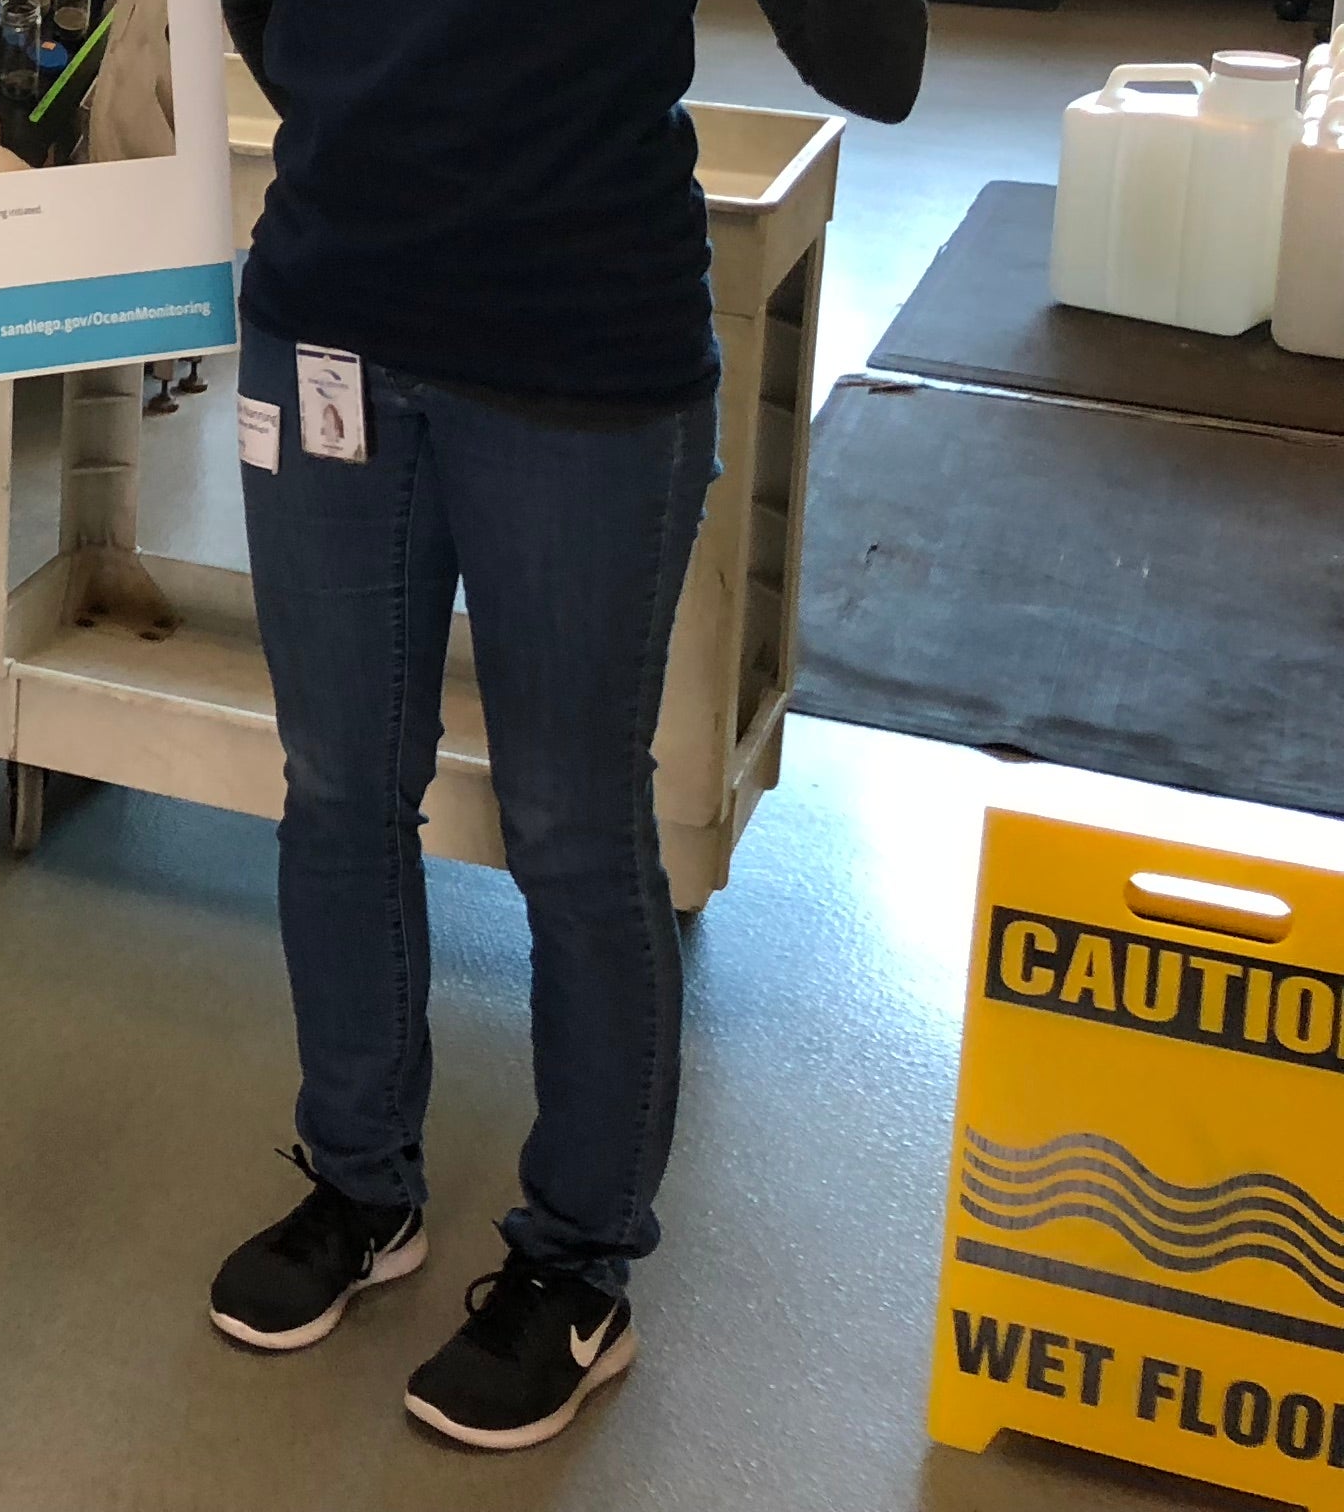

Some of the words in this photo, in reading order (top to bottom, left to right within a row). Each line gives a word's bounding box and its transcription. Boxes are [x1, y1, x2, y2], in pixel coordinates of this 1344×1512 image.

[0, 300, 212, 338] sandiego.gov/OceanMonitoring
[999, 919, 1344, 1059] CAUTIO
[951, 1308, 1115, 1406] WET
[1136, 1355, 1344, 1467] FLOO
